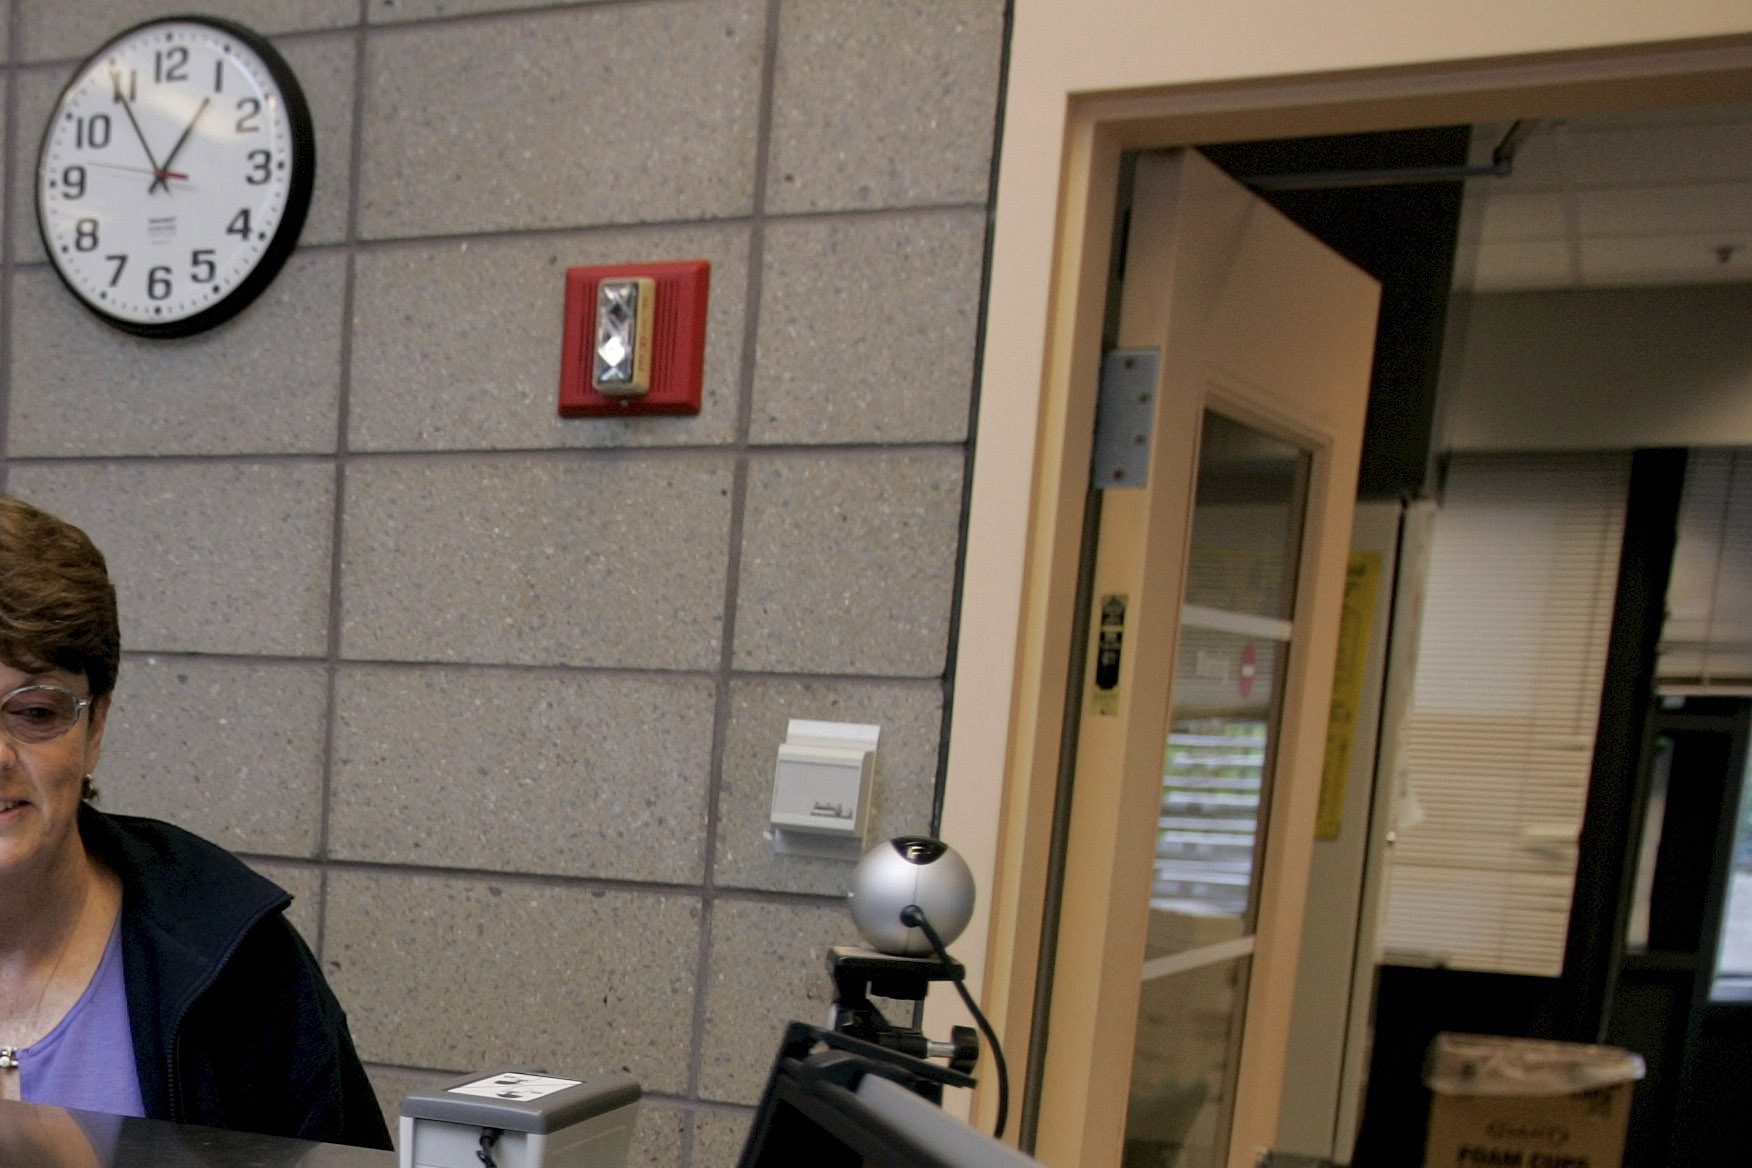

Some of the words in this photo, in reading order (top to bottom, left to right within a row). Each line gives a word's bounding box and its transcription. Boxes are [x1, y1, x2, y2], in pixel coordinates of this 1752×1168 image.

[154, 46, 190, 84] 12
[213, 60, 223, 94] 1
[111, 69, 137, 104] 11
[75, 114, 112, 150] 10
[235, 97, 261, 134] 2
[62, 165, 86, 200] 9
[245, 149, 272, 186] 3
[74, 218, 100, 252] 8
[225, 208, 253, 242] 4
[105, 254, 128, 288] 7
[147, 265, 173, 301] 6
[190, 249, 217, 284] 5
